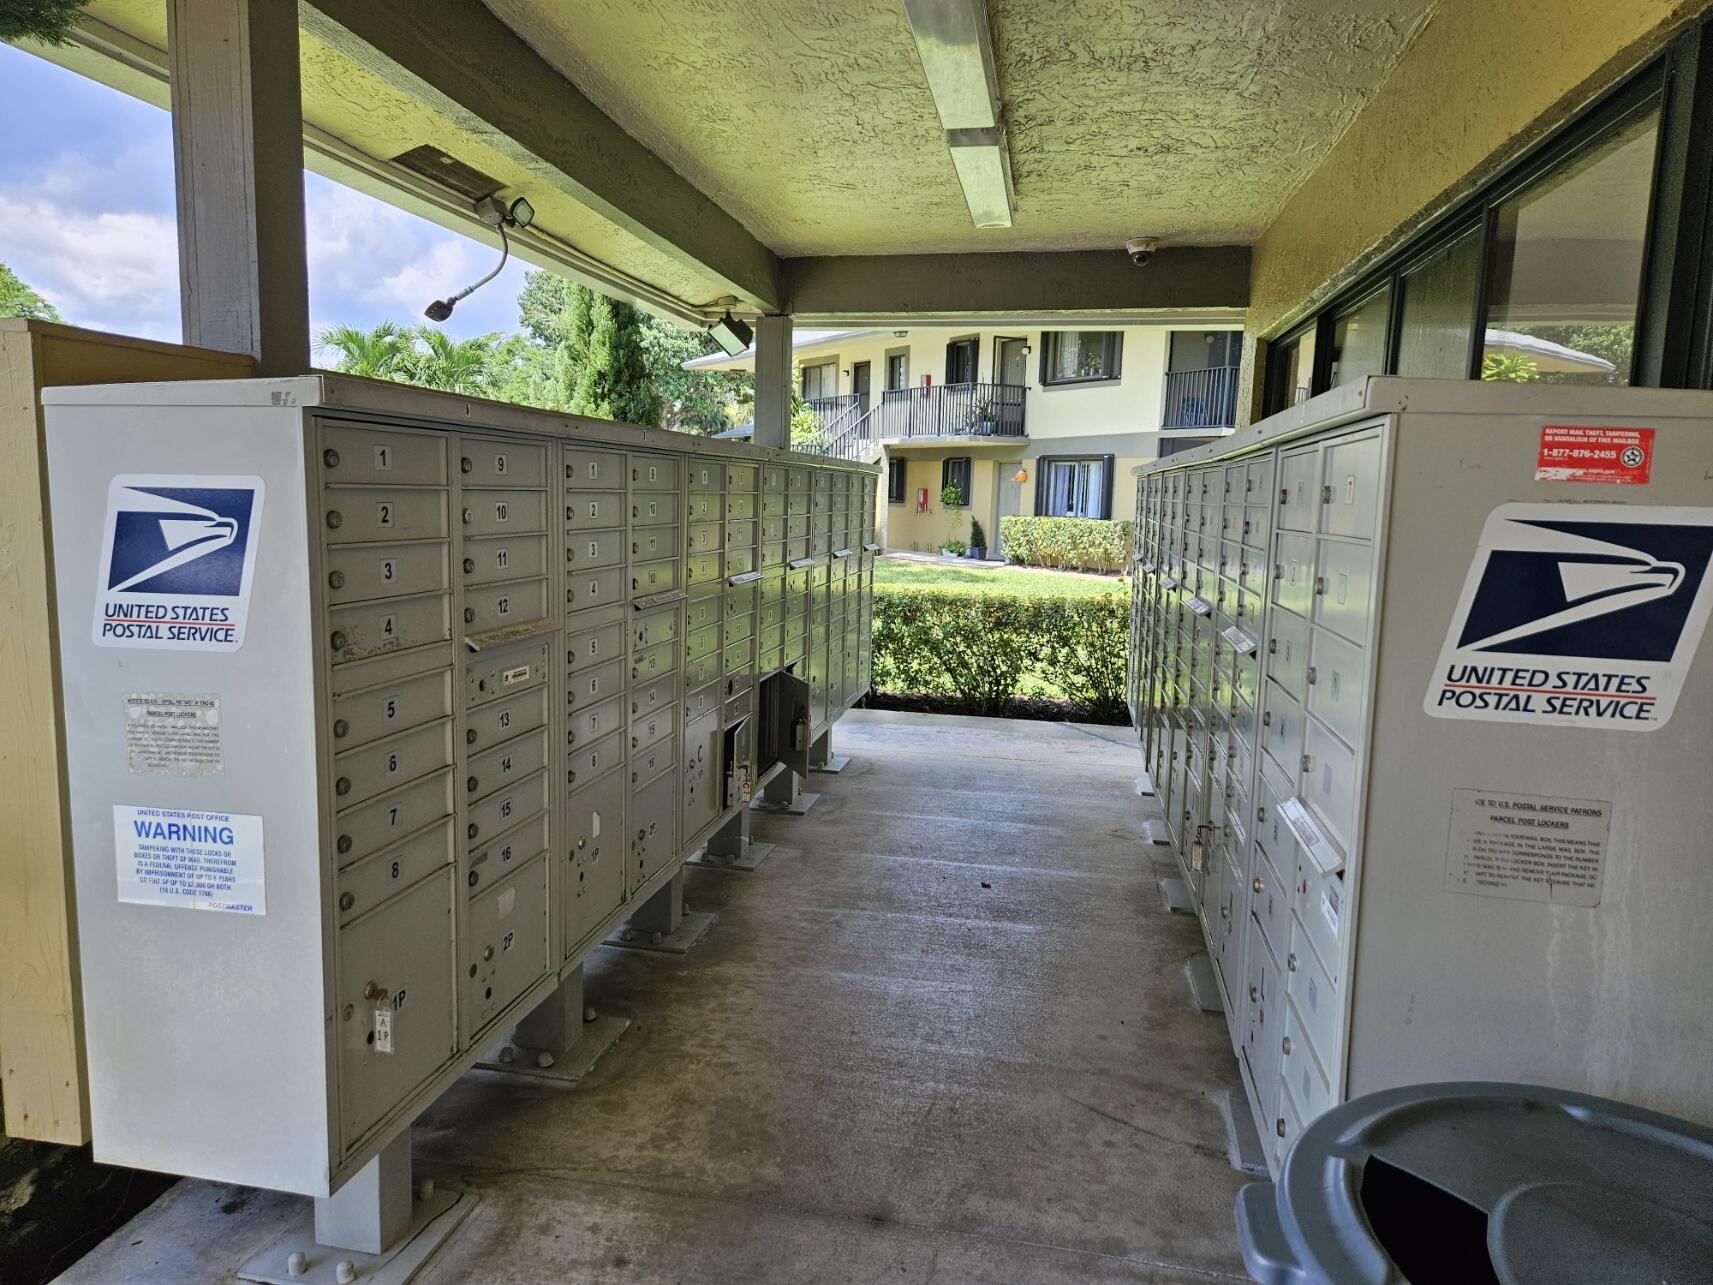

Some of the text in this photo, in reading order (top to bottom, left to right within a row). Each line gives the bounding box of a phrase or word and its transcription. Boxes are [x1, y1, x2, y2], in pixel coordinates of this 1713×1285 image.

[1605, 430, 1640, 438] TAMPERING,
[380, 449, 387, 467] 1
[1543, 448, 1616, 459] 1-877-876-2455
[498, 457, 504, 472] 9
[591, 464, 596, 477] 1
[381, 506, 389, 524] 2
[497, 504, 507, 520] 10
[591, 503, 596, 517] 2
[591, 543, 596, 556] 3
[650, 538, 656, 549] 11
[497, 551, 507, 567] 11
[384, 562, 393, 580] 3
[591, 582, 596, 594] 4
[104, 603, 230, 622] UNITED STATES
[498, 598, 508, 614] 12
[102, 623, 236, 643] POSTAL SERVICE
[384, 618, 392, 636] 4
[591, 642, 596, 654] 5
[591, 679, 596, 691] 6
[1446, 664, 1651, 694] UNITED STATES
[387, 701, 395, 719] 5
[1437, 689, 1655, 720] POSTAL SERVICE
[500, 712, 510, 728] 13
[591, 717, 597, 730] 7
[388, 755, 397, 772] 6
[502, 757, 512, 772] 14
[592, 755, 596, 767] 8
[137, 809, 230, 822] UNITED STATES POST OFFICE
[501, 802, 511, 817] 15
[1488, 800, 1497, 808] TO
[1498, 801, 1510, 809] U.S.
[1512, 802, 1537, 811] POSTAL
[1540, 804, 1569, 814] SERVICE
[1571, 807, 1602, 817] PATRONS
[390, 809, 398, 826] 7
[1490, 815, 1569, 829] PARCEL POST LOCKERS
[133, 820, 234, 845] WARNING
[1567, 839, 1587, 847] MEANS
[138, 844, 232, 858] TAMPERING WITH THESE LOCKS OR
[502, 847, 512, 862] 16
[592, 848, 600, 862] 1P
[162, 854, 179, 862] THEFT
[203, 857, 237, 866] THEREFROM
[144, 869, 186, 879] IMPRISONMENT
[218, 875, 236, 883] YEARS
[149, 862, 172, 870] FEDERAL
[174, 863, 198, 872] OFFENSE
[199, 865, 234, 875] PUNISHABLE
[391, 862, 399, 880] 8
[207, 882, 215, 890] OR
[208, 902, 253, 912] POSTMASTER
[503, 932, 514, 951] 2P
[392, 989, 406, 1012] 1P
